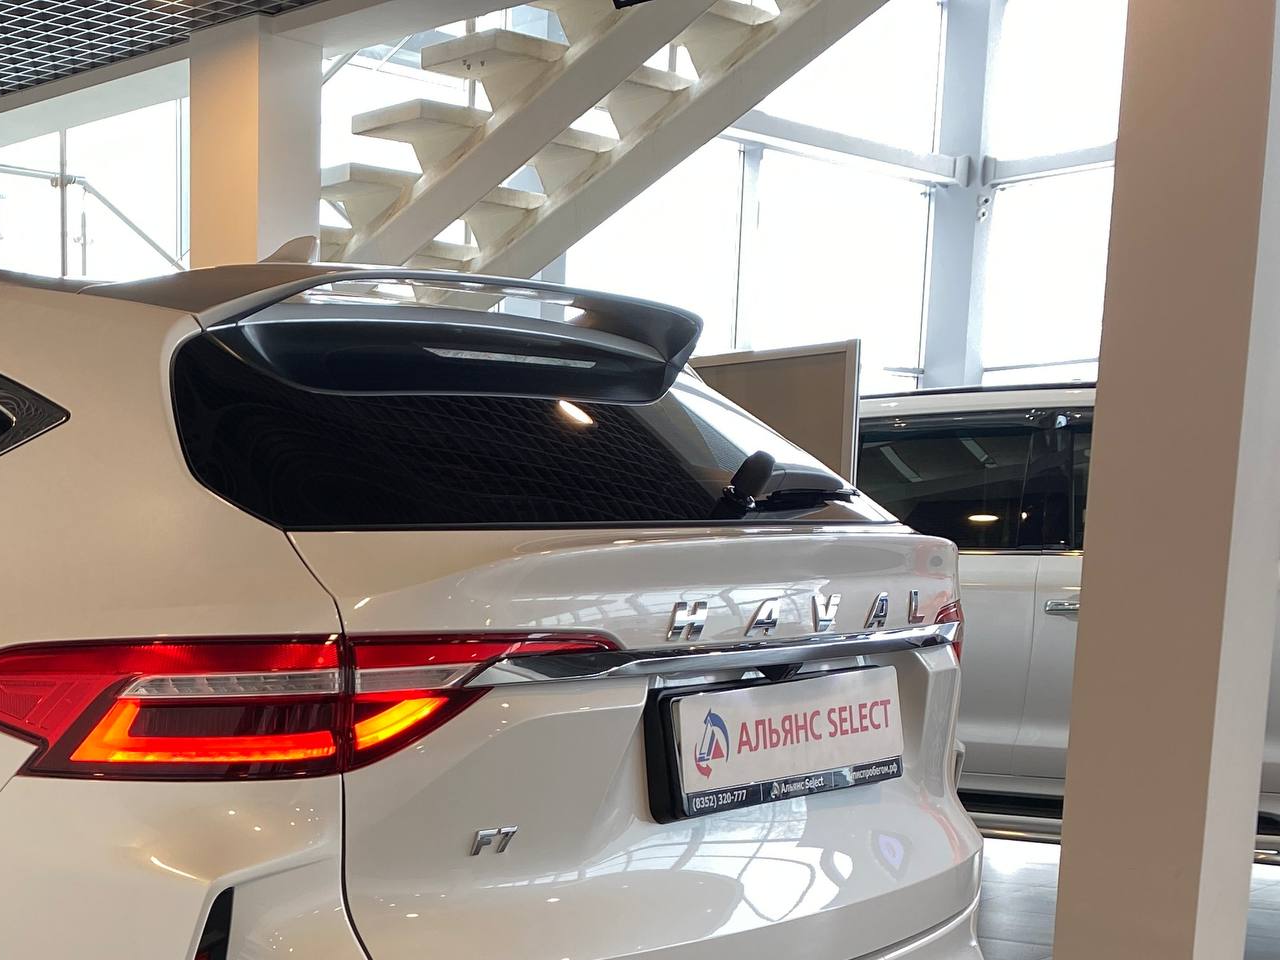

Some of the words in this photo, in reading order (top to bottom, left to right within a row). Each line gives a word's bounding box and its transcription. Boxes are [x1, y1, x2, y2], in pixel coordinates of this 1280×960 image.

[666, 589, 925, 641] HAVAL
[737, 709, 822, 755] АЛЬЯНС
[828, 699, 891, 738] SELECT
[781, 780, 804, 794] Альянс
[805, 776, 825, 790] Select
[692, 795, 717, 812] (8352)
[718, 790, 747, 805] 320-777
[470, 826, 518, 856] F7
